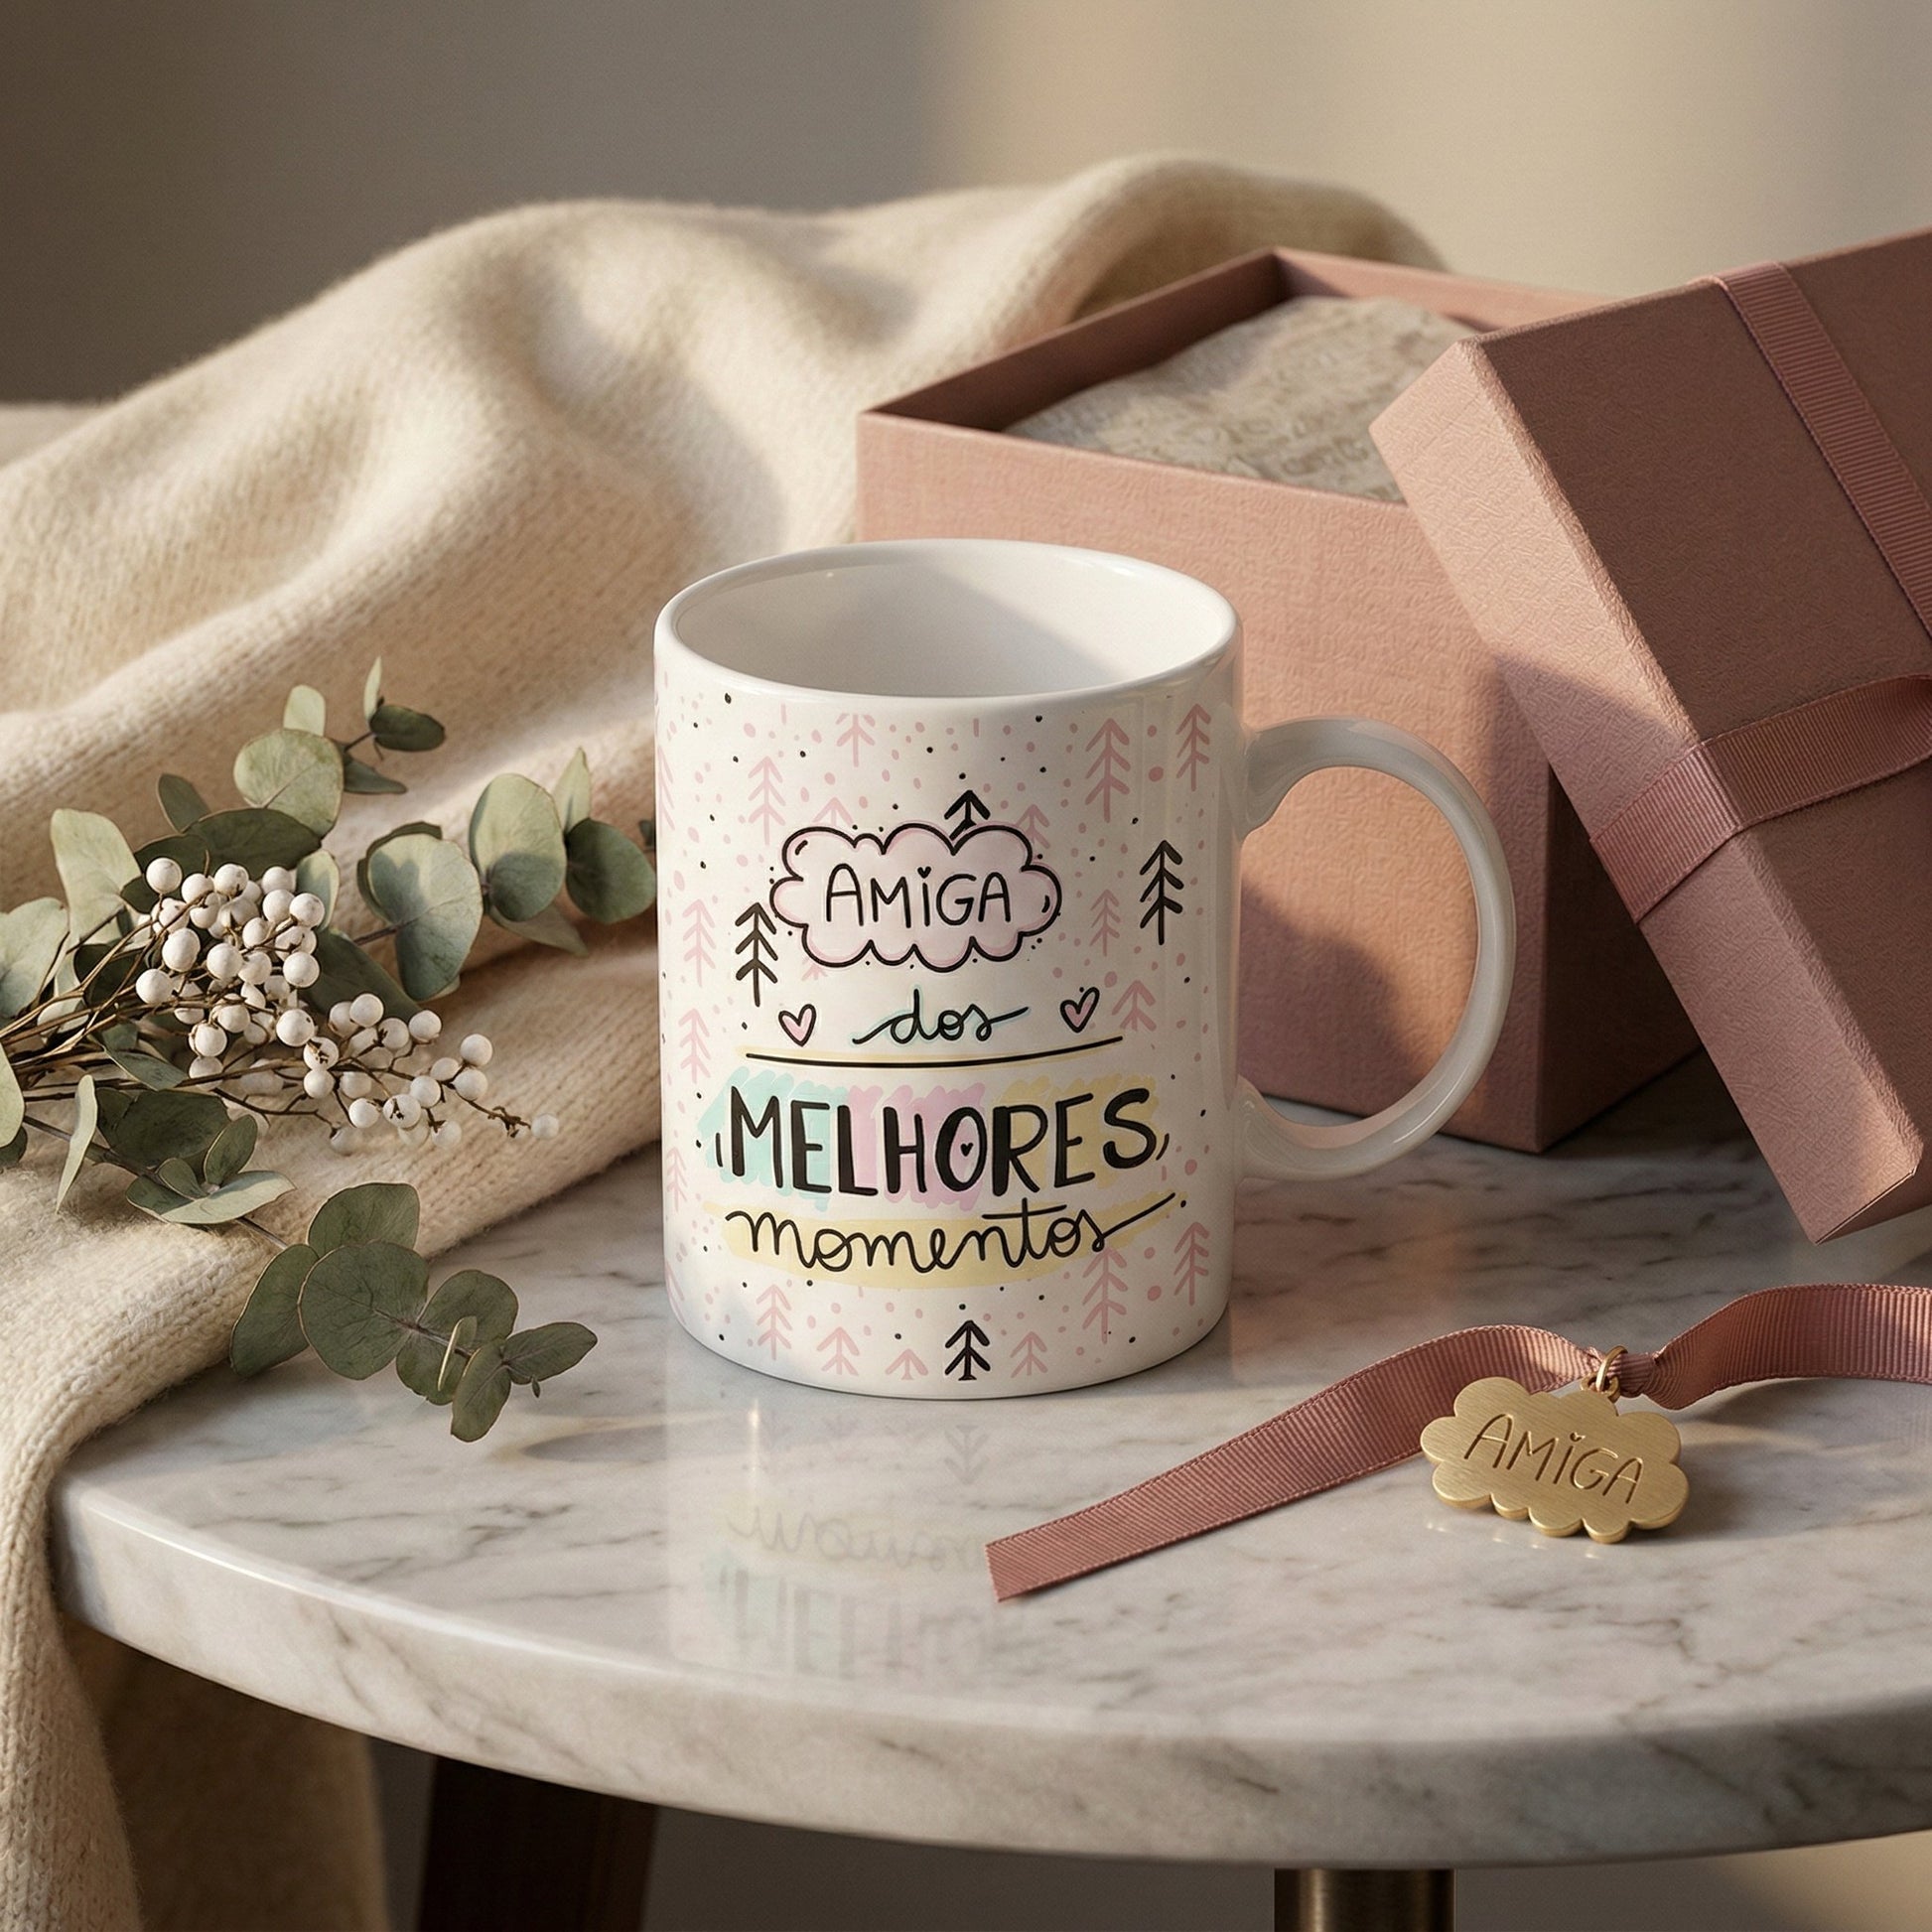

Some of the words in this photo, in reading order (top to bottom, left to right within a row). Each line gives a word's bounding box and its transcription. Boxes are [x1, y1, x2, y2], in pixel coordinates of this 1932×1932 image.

[852, 988, 1030, 1045] dos
[730, 1087, 1156, 1196] MELHORES
[725, 1193, 1175, 1273] momentos
